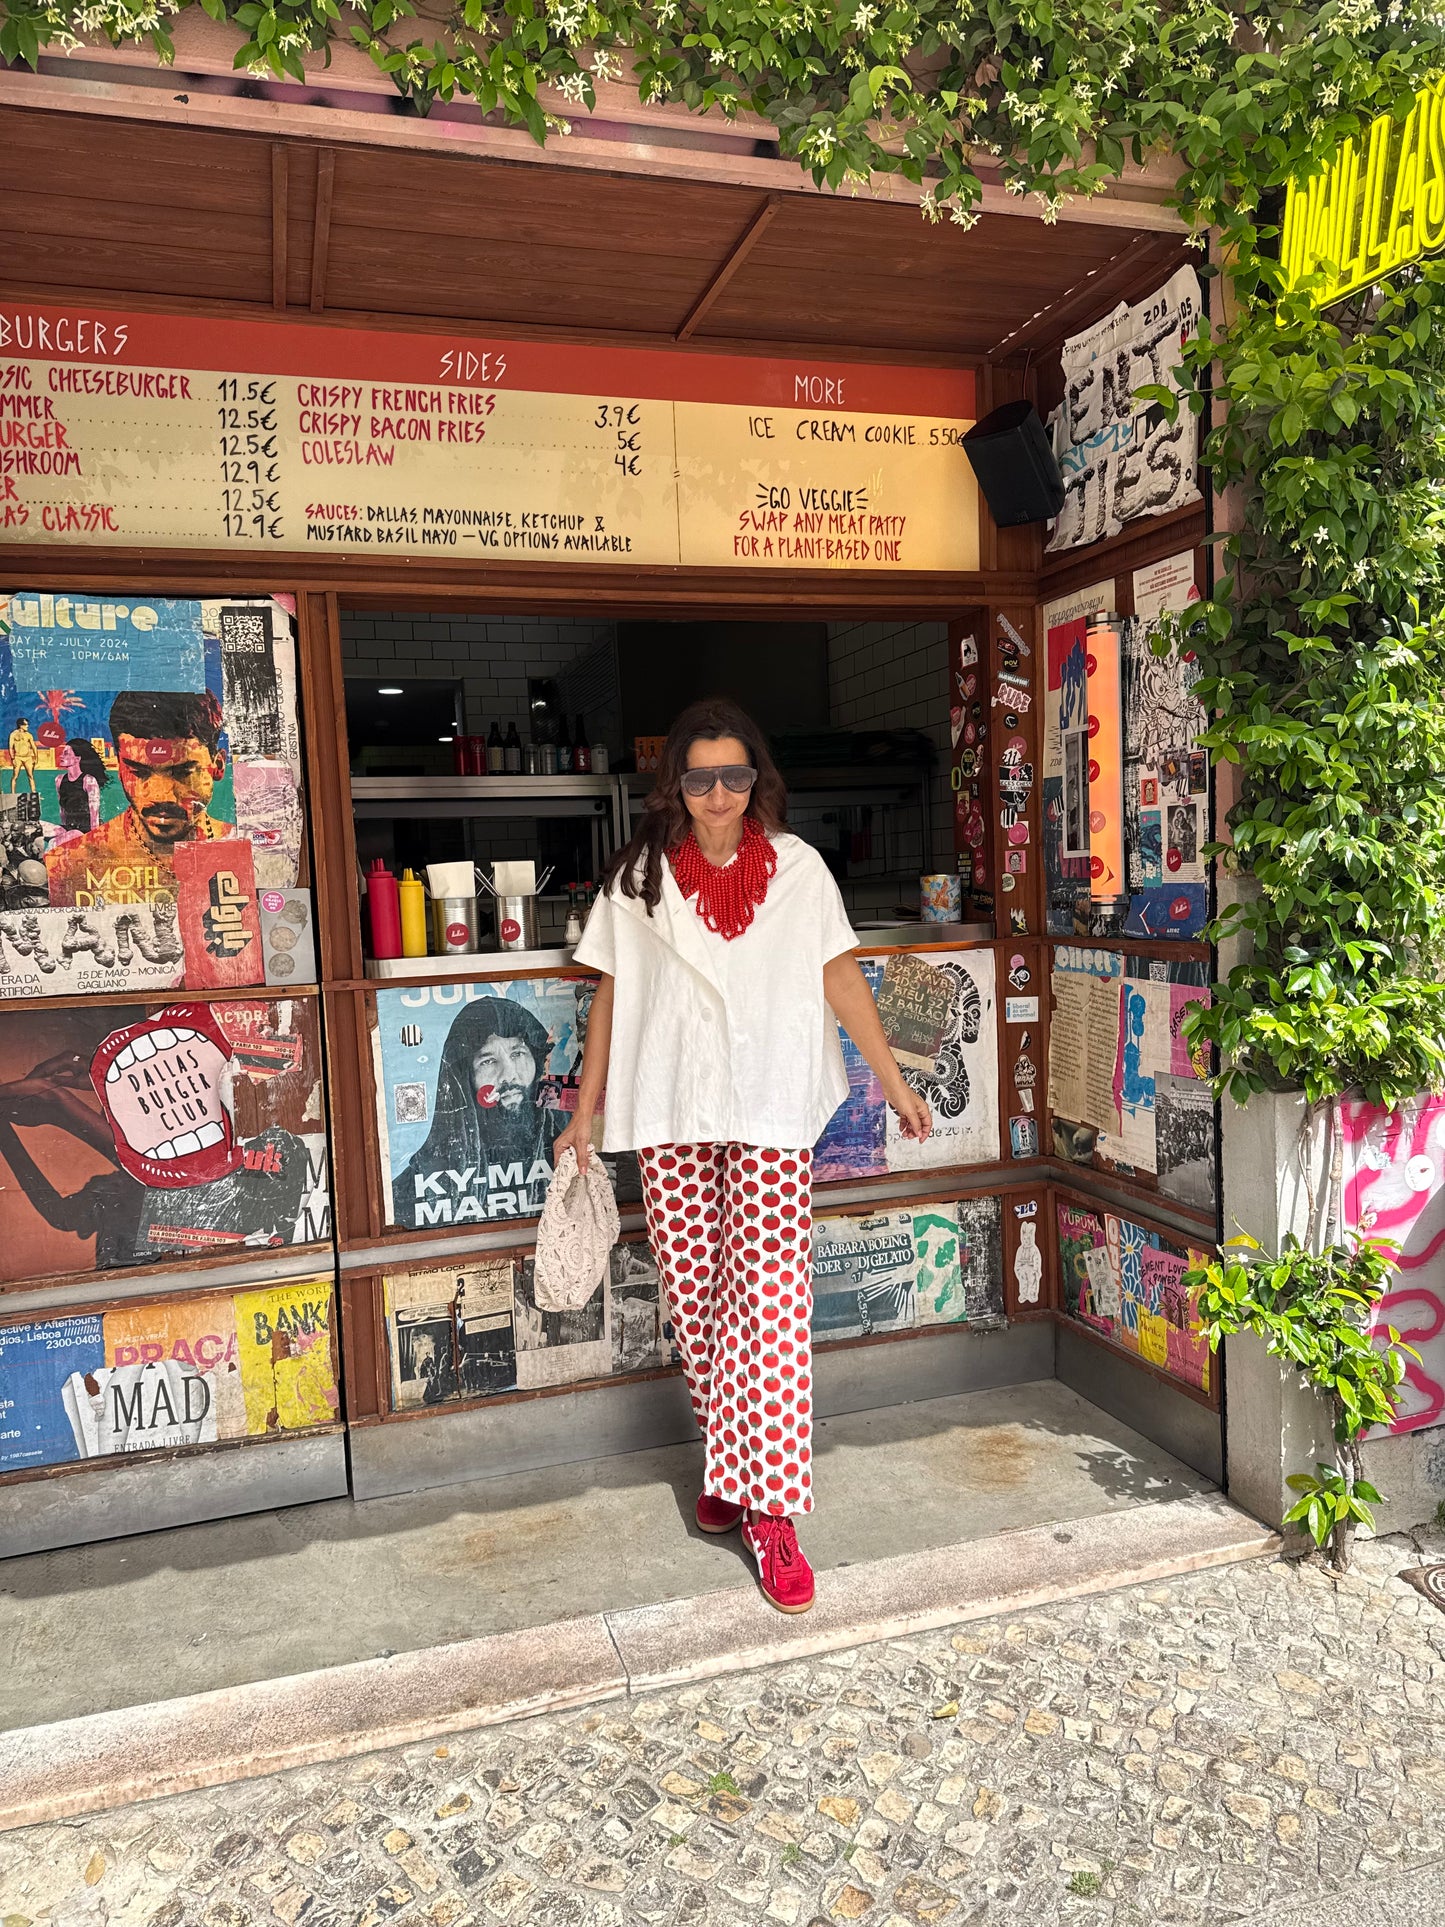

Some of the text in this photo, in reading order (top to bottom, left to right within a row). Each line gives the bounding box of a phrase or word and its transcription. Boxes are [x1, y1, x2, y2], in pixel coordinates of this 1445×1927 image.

[1143, 298, 1167, 326] ZDB
[0, 314, 129, 356] BURGERS
[438, 349, 508, 383] SIDES
[48, 367, 192, 400] CHEESEBURGER
[217, 378, 277, 405] 11.5€
[794, 374, 846, 405] MORE
[297, 383, 497, 416] CRISPY FRENCH FRIES
[218, 408, 278, 430] 12.5€
[298, 410, 486, 444] CRISPY BACON FRIES
[594, 404, 641, 429] 3.9€
[617, 430, 642, 452] 5€
[749, 416, 776, 439] ICE
[796, 420, 856, 443] CREAM
[864, 425, 916, 446] COOKIE
[219, 434, 278, 458] 12.5€
[302, 440, 395, 467] COLESLAW
[220, 460, 281, 484] 12.9€
[614, 454, 642, 477] 4€
[221, 488, 281, 513] 12.5€
[769, 486, 856, 512] GO VEGGIE
[42, 506, 119, 532] CLASSIC
[222, 514, 284, 539] 12.9€
[304, 503, 363, 521] SAUCES:
[521, 512, 585, 531] KETCHUP
[739, 509, 907, 537] SWAP ANY MEAT PATTY
[377, 525, 418, 545] BASIL
[422, 528, 458, 546] MAYO
[478, 529, 500, 548] VG
[503, 532, 560, 551] OPTIONS
[563, 534, 633, 553] AVAILABLE
[733, 535, 902, 562] FOR A PLANT-BASED ONE
[39, 636, 54, 646] 12
[99, 638, 129, 649] 2024
[70, 650, 130, 662] 10PM/6AM
[85, 865, 162, 890] MOTEL
[1, 974, 41, 985] ERA DA
[77, 966, 177, 980] 15 DE MAIO MONICA
[77, 979, 127, 990] GAGLIANO
[894, 985, 925, 1003] BIEU
[127, 1049, 199, 1093] DALLAS
[137, 1072, 212, 1116] BURGER
[159, 1097, 208, 1132] CLUB
[816, 1234, 909, 1259] BÁRBARA BOEING
[870, 1249, 911, 1267] GELATO
[440, 1264, 466, 1273] LOCO
[268, 1290, 294, 1304] THE
[27, 1329, 62, 1343] Lisboa
[34, 1322, 43, 1330] &
[45, 1334, 101, 1350] 2300-0400
[111, 1376, 211, 1434] MAD
[114, 1439, 156, 1453] ENTRADA
